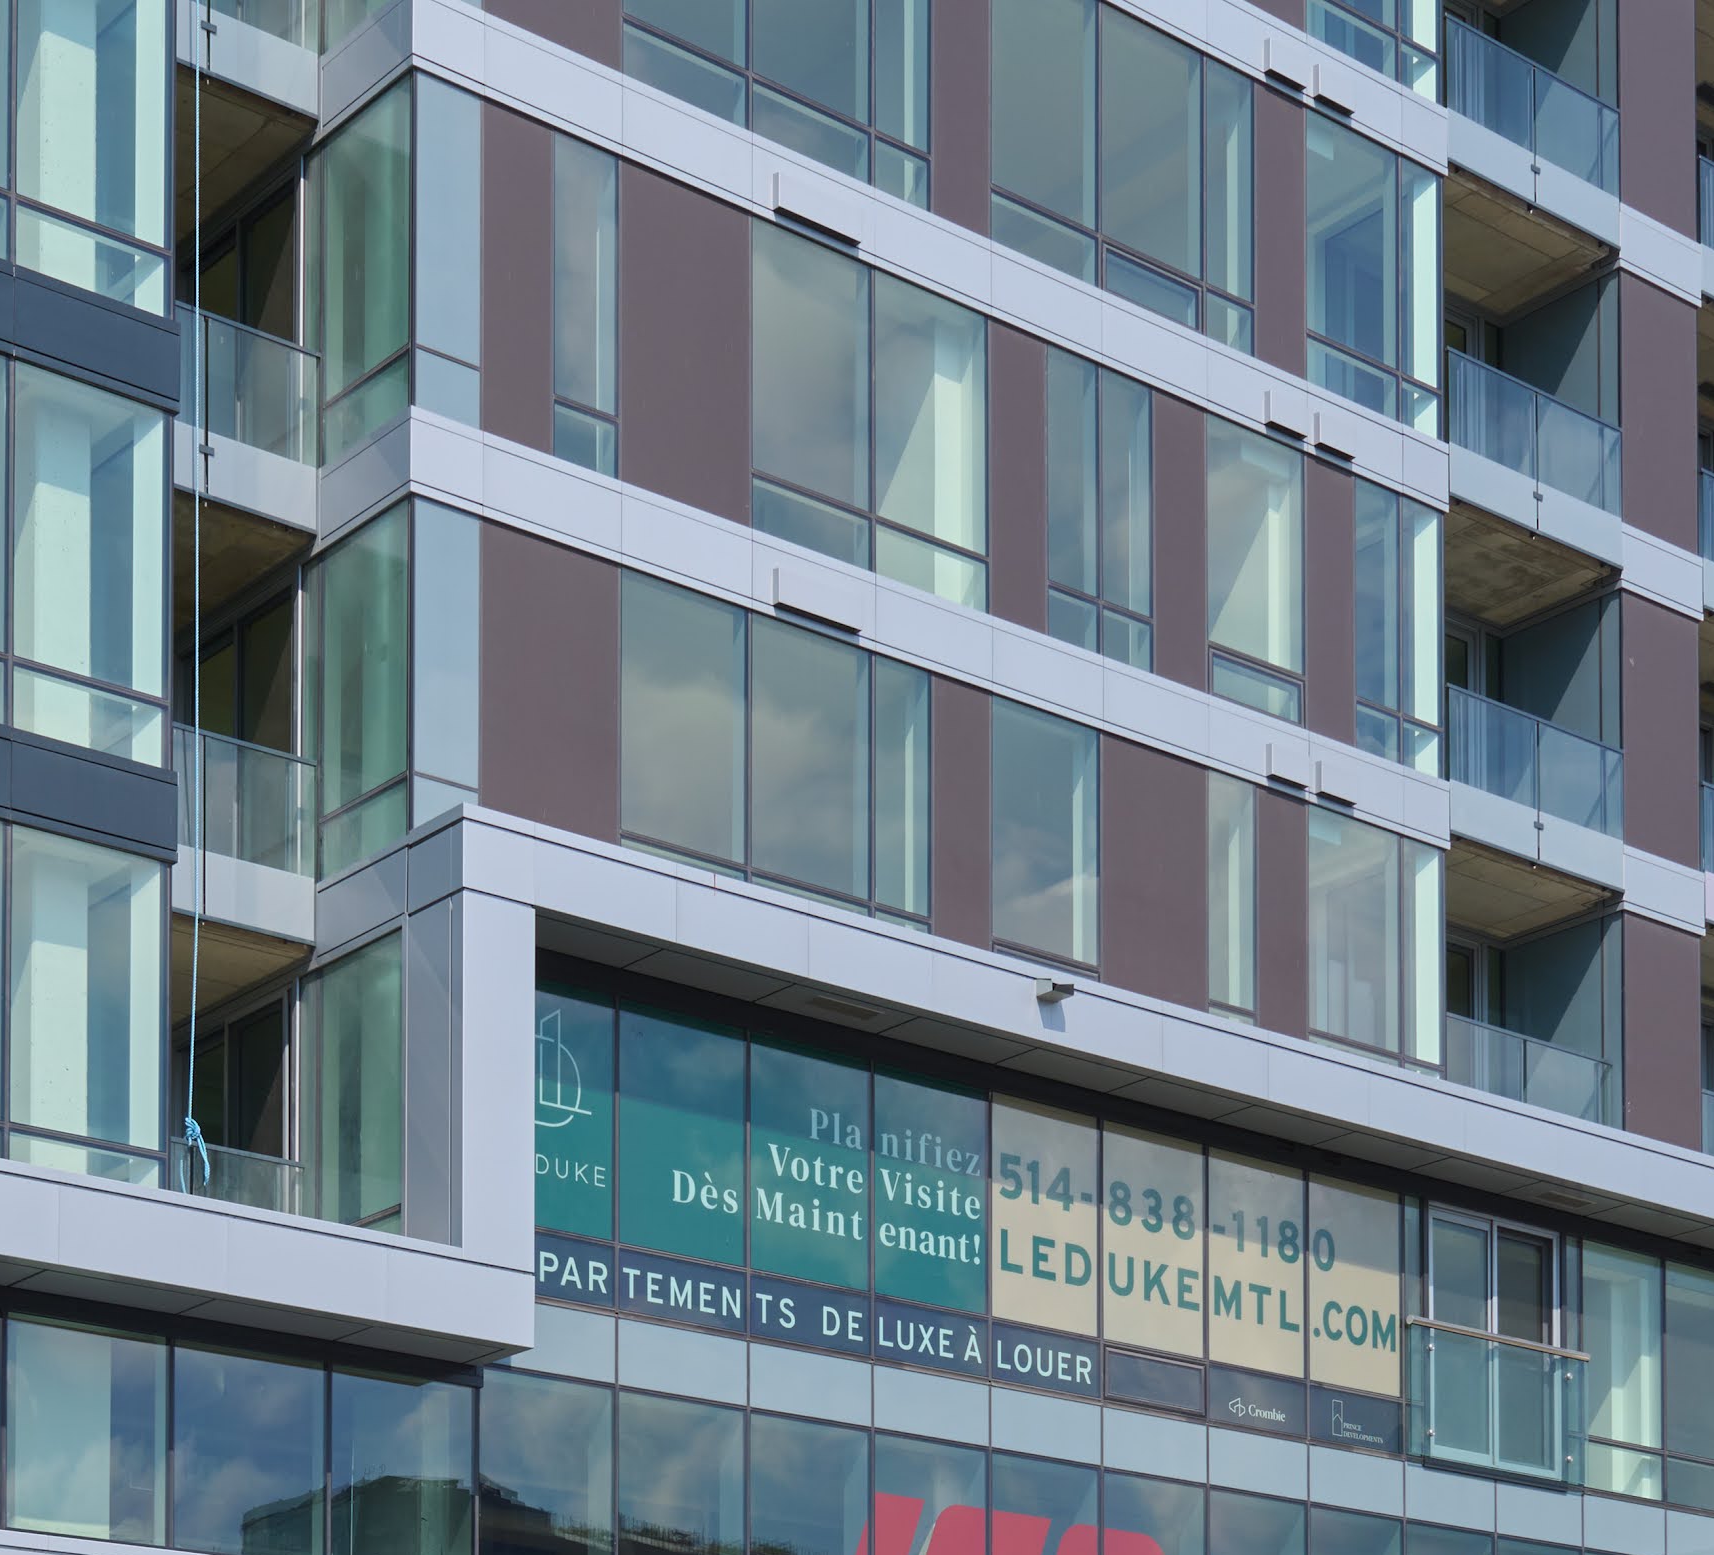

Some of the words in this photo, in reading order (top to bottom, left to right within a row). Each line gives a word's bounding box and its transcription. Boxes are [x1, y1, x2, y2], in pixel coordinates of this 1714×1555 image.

[810, 1108, 982, 1177] Planifiez
[672, 1172, 739, 1214] Dès
[756, 1188, 983, 1266] Maintenant!
[768, 1143, 864, 1194] Votre
[879, 1168, 982, 1220] Visite
[998, 1152, 1336, 1272] 514-838-1180
[999, 1228, 1398, 1353] LEDUKEMTL.COM
[822, 1305, 864, 1342] DE
[878, 1316, 954, 1358] LUXE
[963, 1325, 983, 1364] À
[996, 1340, 1093, 1385] LOUER
[1248, 1404, 1286, 1423] Crombie
[1343, 1422, 1363, 1432] PRINCE
[1343, 1431, 1384, 1445] DEVELOPMENTS
